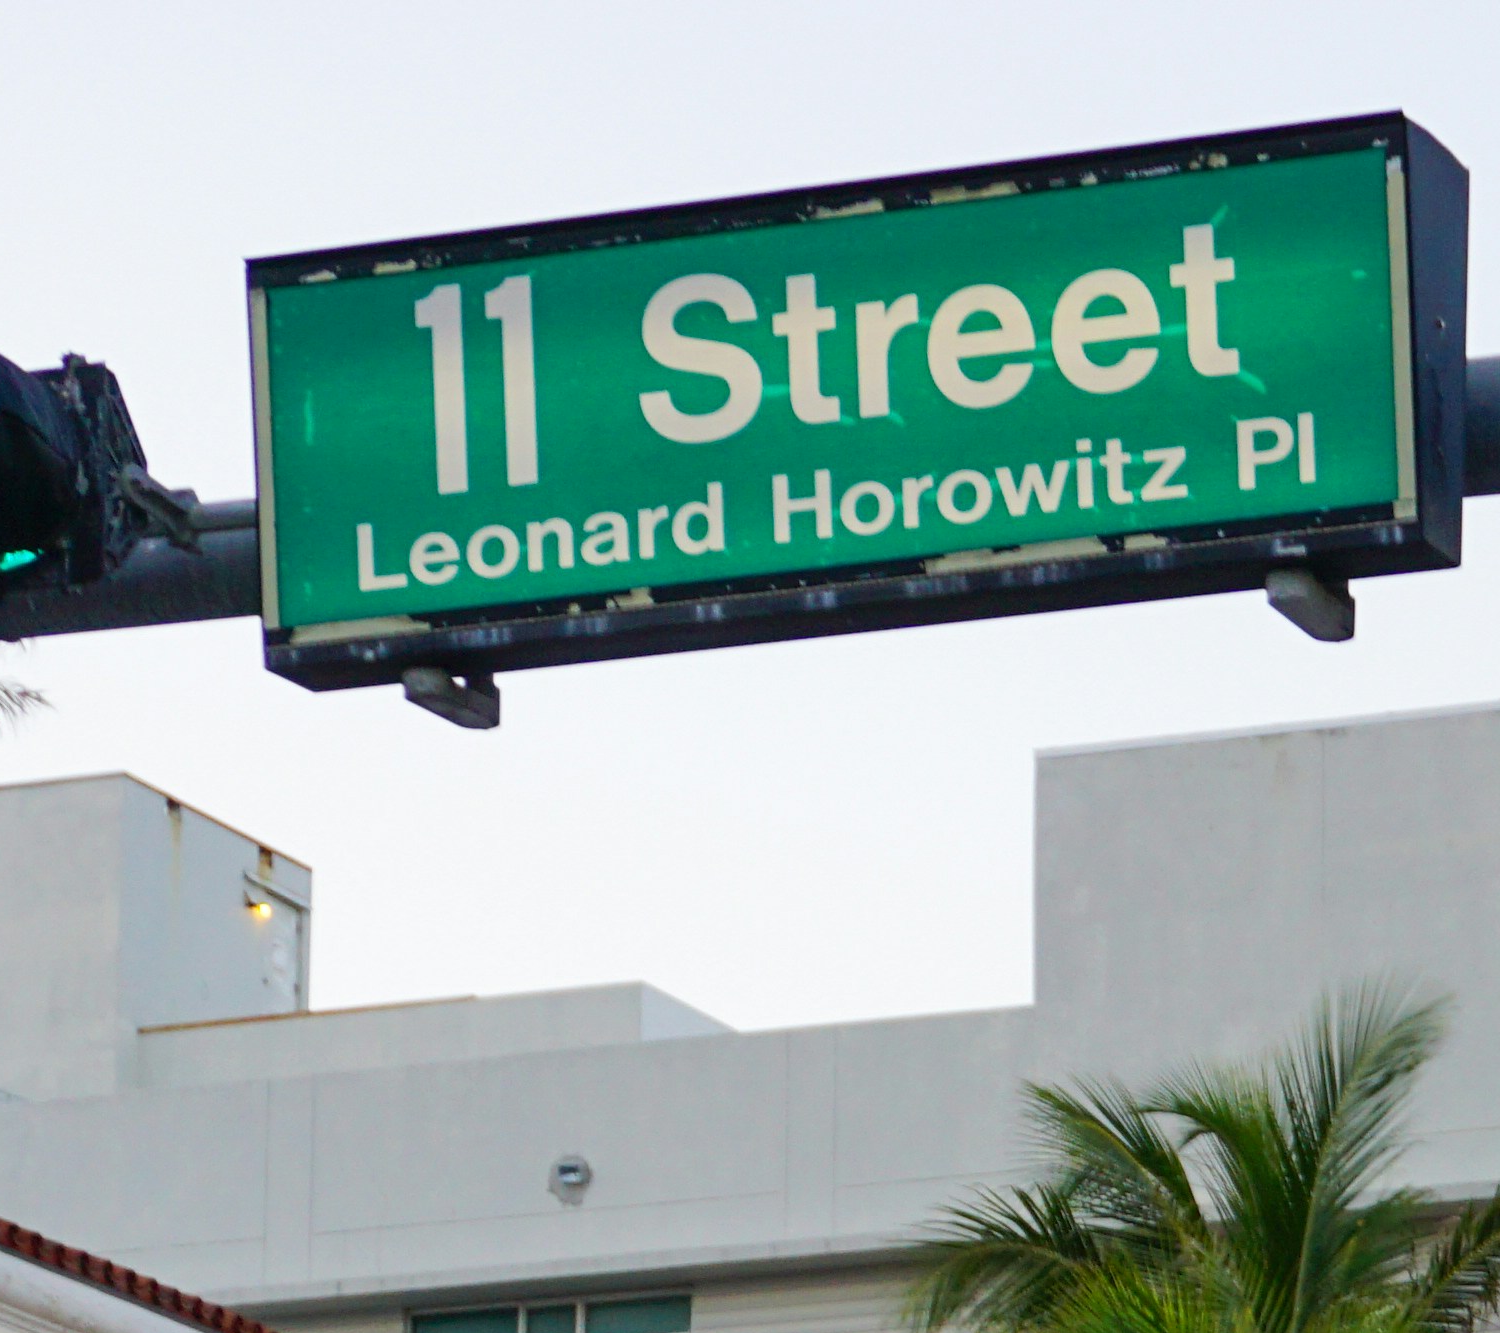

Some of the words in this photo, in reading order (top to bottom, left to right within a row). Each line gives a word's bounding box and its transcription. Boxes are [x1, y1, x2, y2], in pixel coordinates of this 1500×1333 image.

[414, 274, 539, 495] 11
[639, 223, 1241, 444] Street
[356, 481, 725, 592] Leonard
[772, 437, 1188, 544] Horowitz
[1236, 411, 1316, 491] Pl
